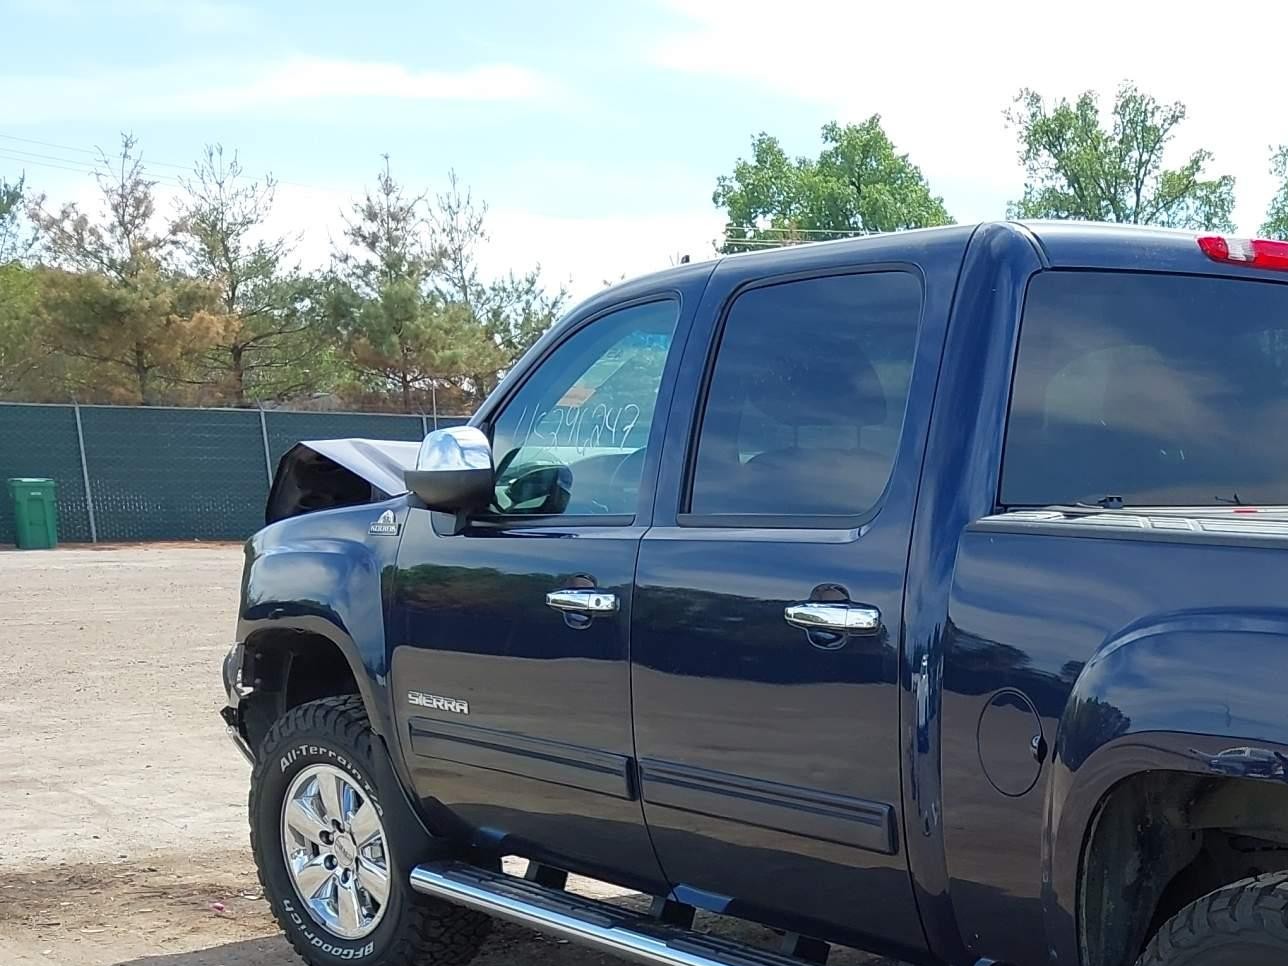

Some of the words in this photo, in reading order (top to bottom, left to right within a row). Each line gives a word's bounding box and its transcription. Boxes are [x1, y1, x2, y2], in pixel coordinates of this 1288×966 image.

[408, 690, 469, 715] SIERRA
[280, 744, 362, 780] All-Terrain
[282, 899, 375, 959] BFGoodrich
